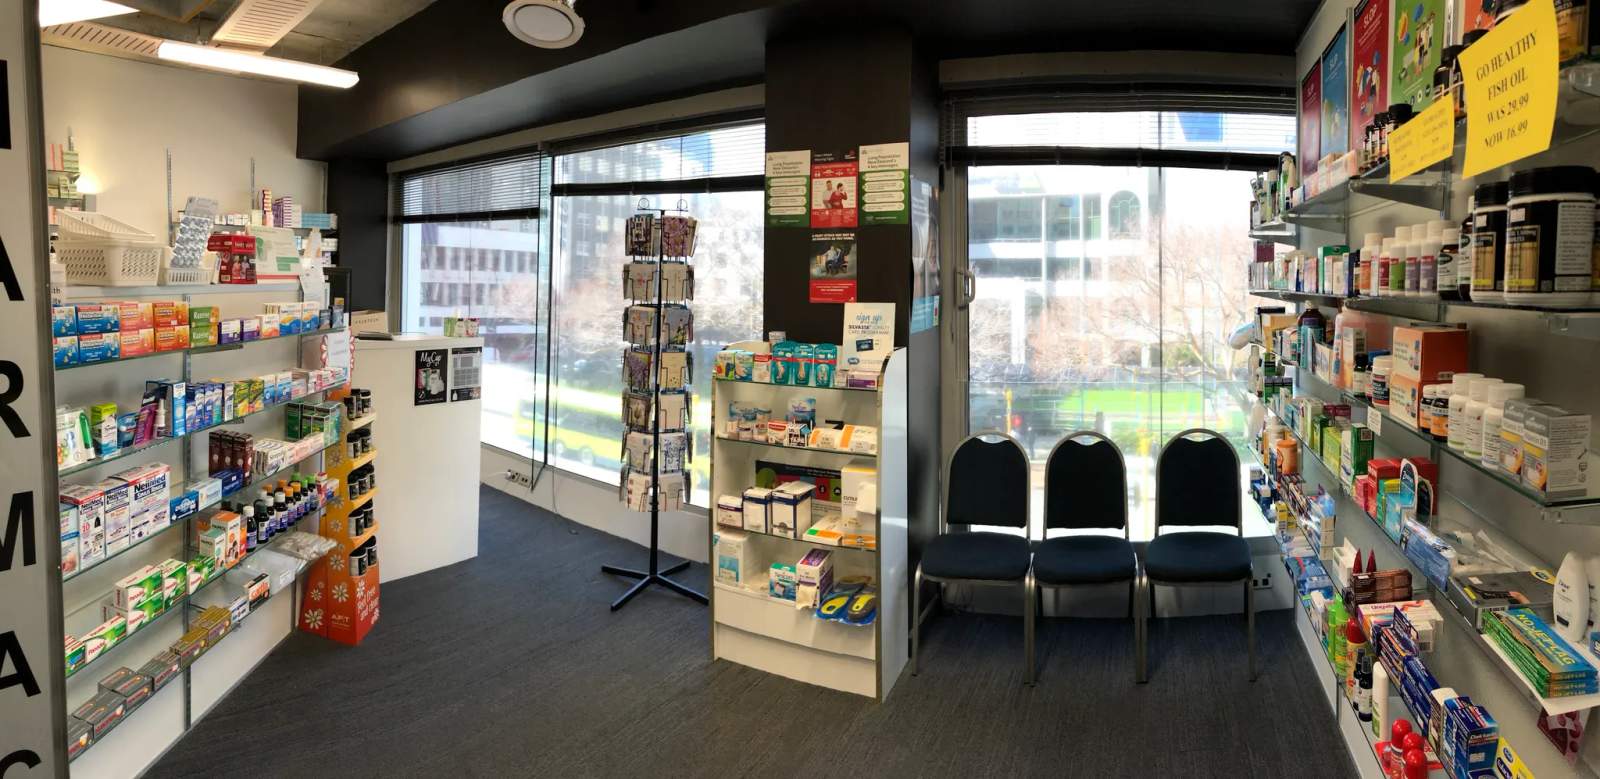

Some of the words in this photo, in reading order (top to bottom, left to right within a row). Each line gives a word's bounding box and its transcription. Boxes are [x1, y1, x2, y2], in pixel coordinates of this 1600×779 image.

[1475, 63, 1491, 82] GO
[1490, 31, 1537, 74] HEALTHY
[1487, 81, 1509, 101] FISH
[1510, 67, 1529, 90] OIL
[1486, 108, 1506, 126] WAS
[1506, 93, 1530, 117] 29.99
[1483, 130, 1507, 149] NOW
[1506, 120, 1529, 142] 16.99
